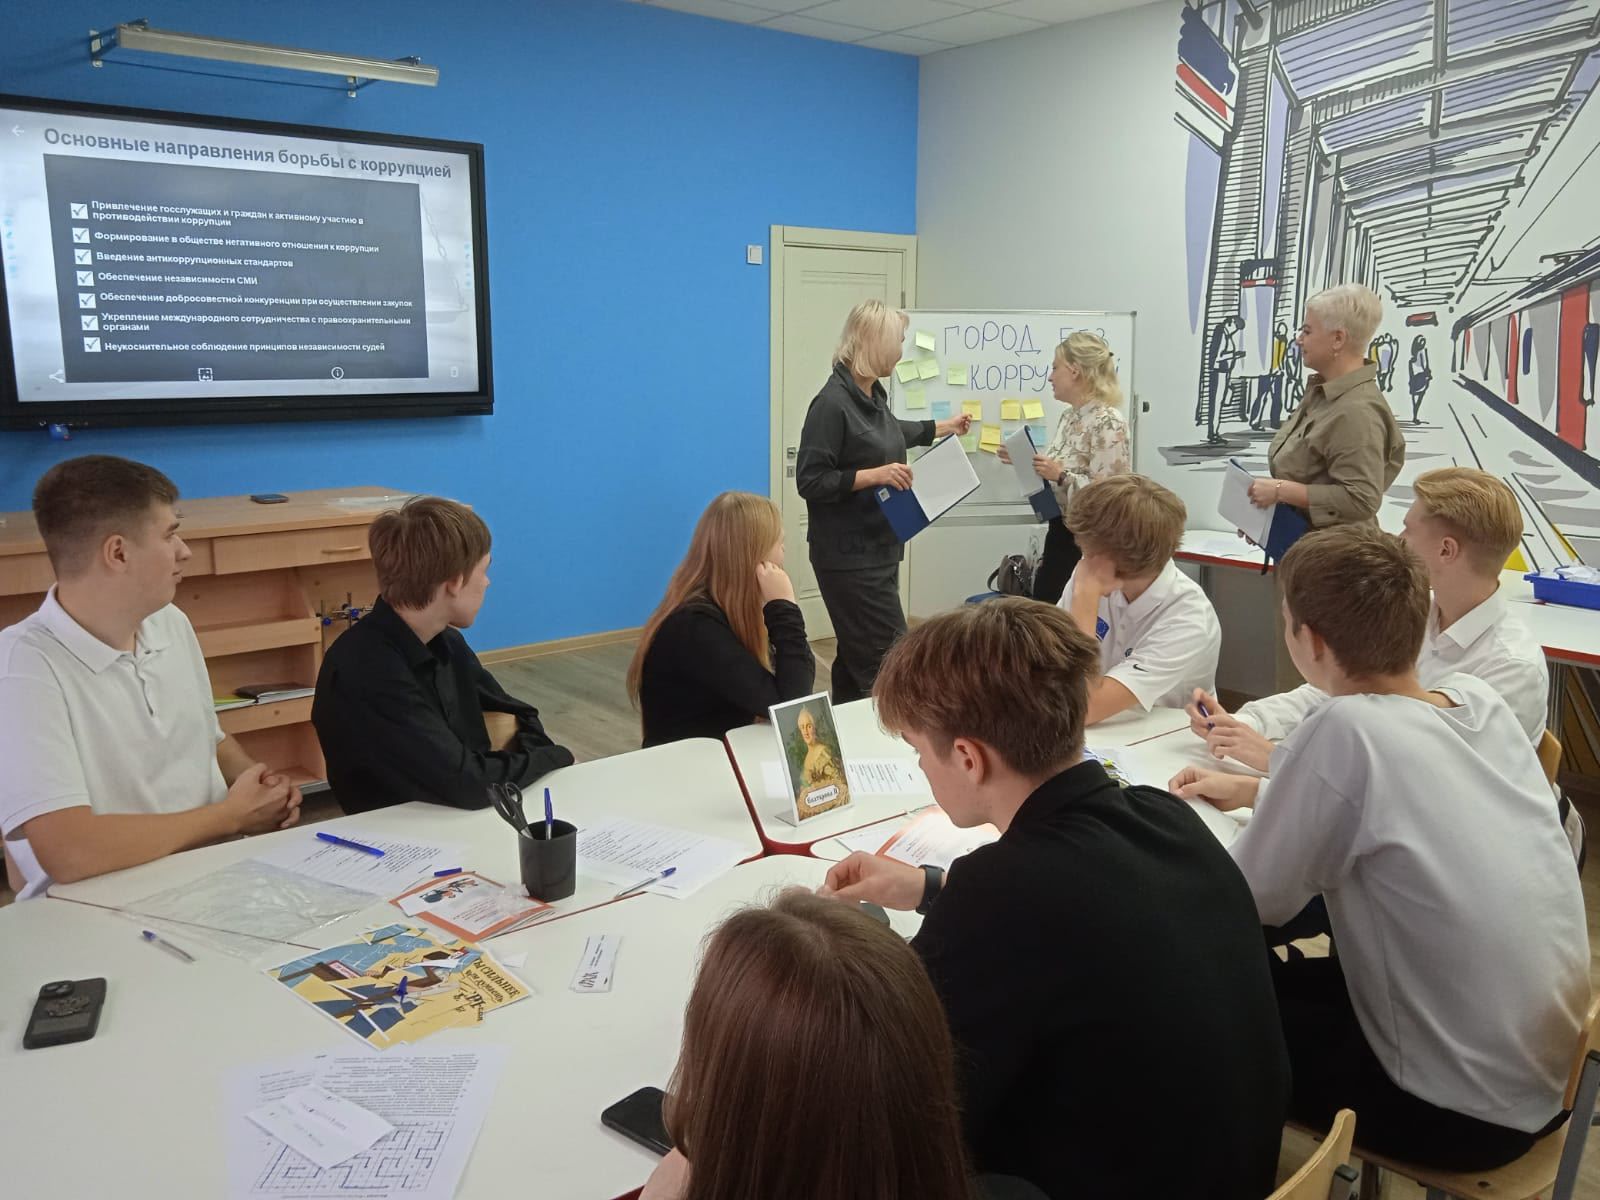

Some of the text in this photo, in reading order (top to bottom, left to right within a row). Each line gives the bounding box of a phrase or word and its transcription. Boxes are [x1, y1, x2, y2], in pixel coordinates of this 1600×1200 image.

[44, 128, 452, 178] Основные направления борьбы с коррупцией
[91, 200, 158, 213] Привлечение
[160, 206, 222, 217] госслужащих
[231, 209, 268, 221] граждан
[275, 213, 321, 224] активному
[322, 216, 357, 225] участию
[92, 213, 232, 226] противодействии коррупции
[94, 231, 170, 243] Формирование
[179, 236, 224, 247] обществе
[226, 239, 281, 248] негативного
[282, 242, 329, 251] отношения
[335, 245, 379, 255] коррупции
[96, 252, 294, 268] Введение антикоррупционных стандартов
[98, 272, 258, 285] Обеспечение независимости СМИ
[100, 292, 164, 303] Обеспечение
[165, 294, 243, 304] добросовестной
[244, 297, 301, 306] конкуренции
[301, 299, 318, 307] при
[318, 300, 382, 309] осуществлении
[101, 312, 160, 324] Укрепление
[161, 314, 240, 324] международного
[241, 316, 310, 326] сотрудничества
[317, 316, 411, 326] правоохранительными
[102, 323, 150, 332] органами
[944, 320, 1042, 358] ГОРОД
[104, 342, 385, 353] Неукоснительное соблюдение принципов независимости судей
